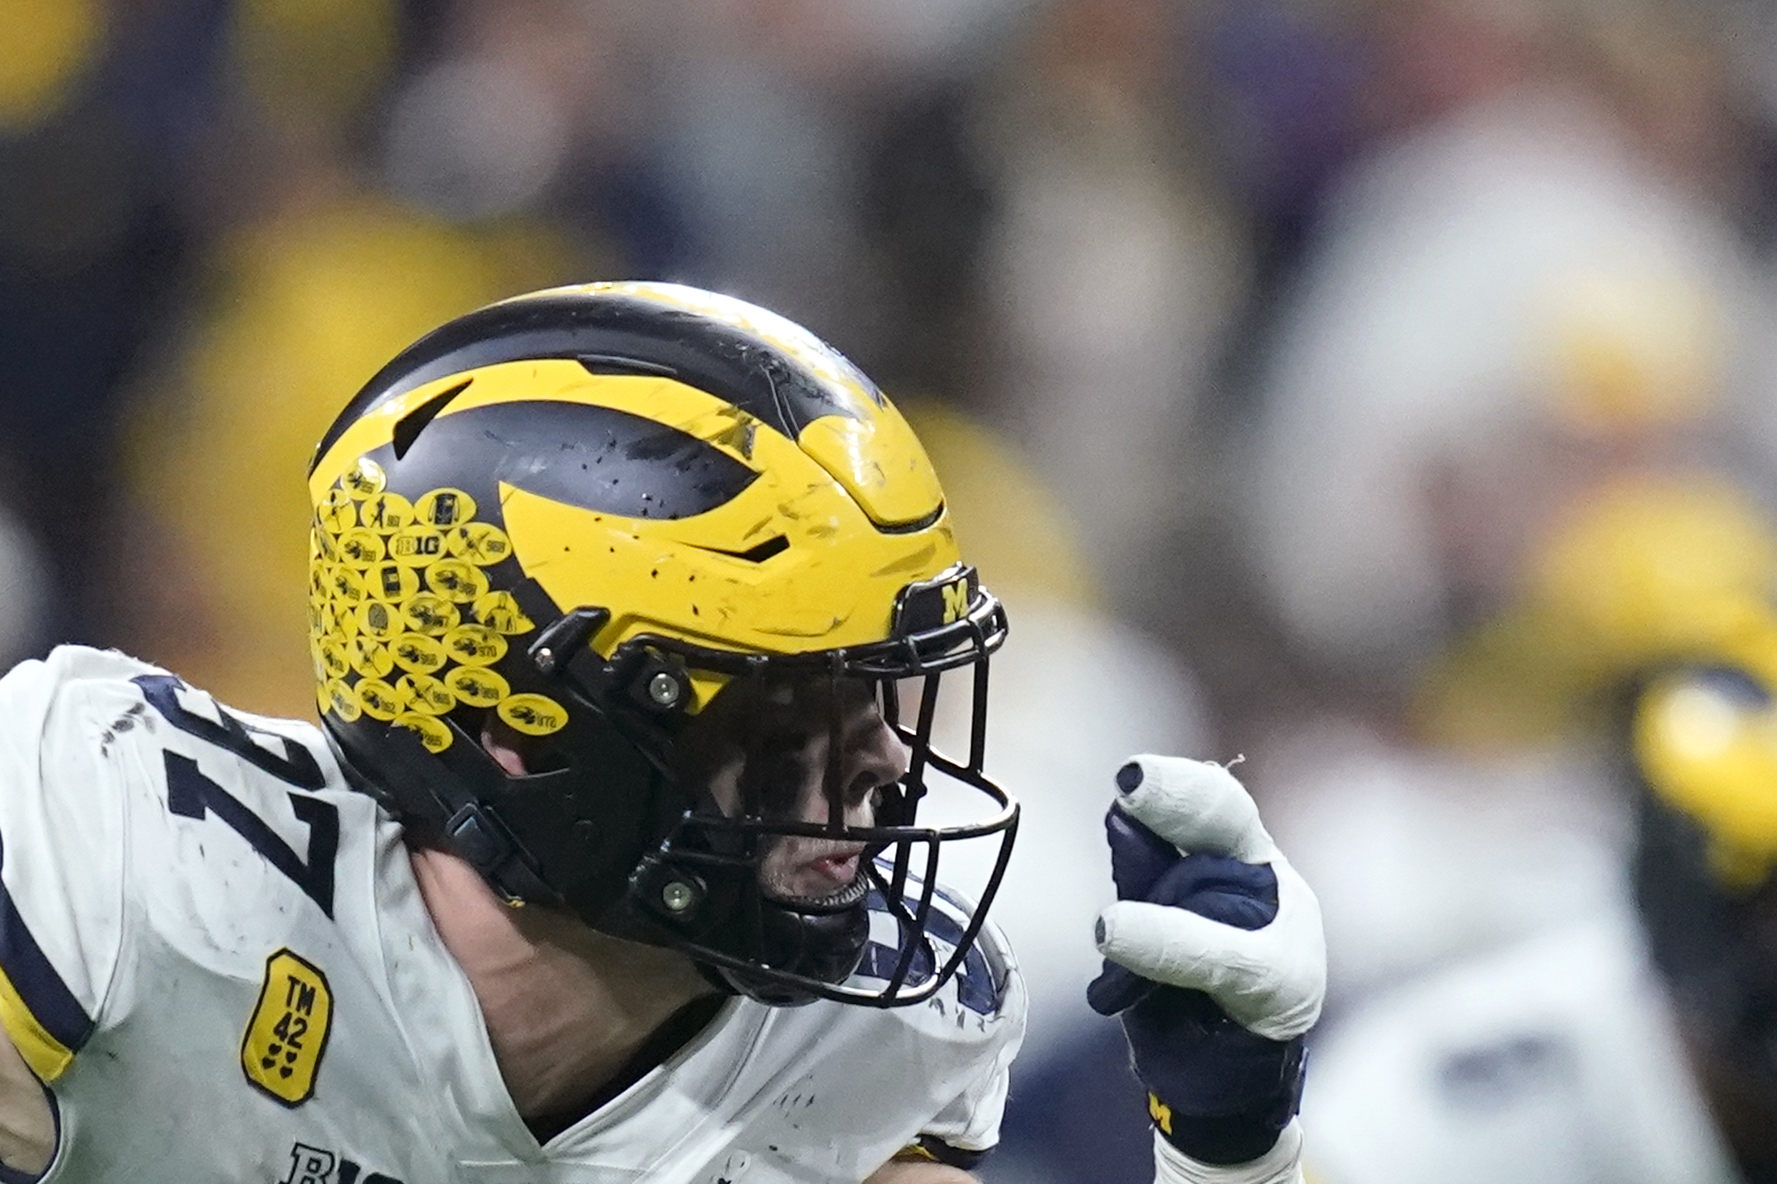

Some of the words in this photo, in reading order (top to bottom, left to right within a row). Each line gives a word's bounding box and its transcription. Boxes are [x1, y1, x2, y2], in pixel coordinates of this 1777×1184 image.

[941, 577, 969, 625] M
[286, 974, 316, 1016] TM
[273, 1011, 308, 1050] 42
